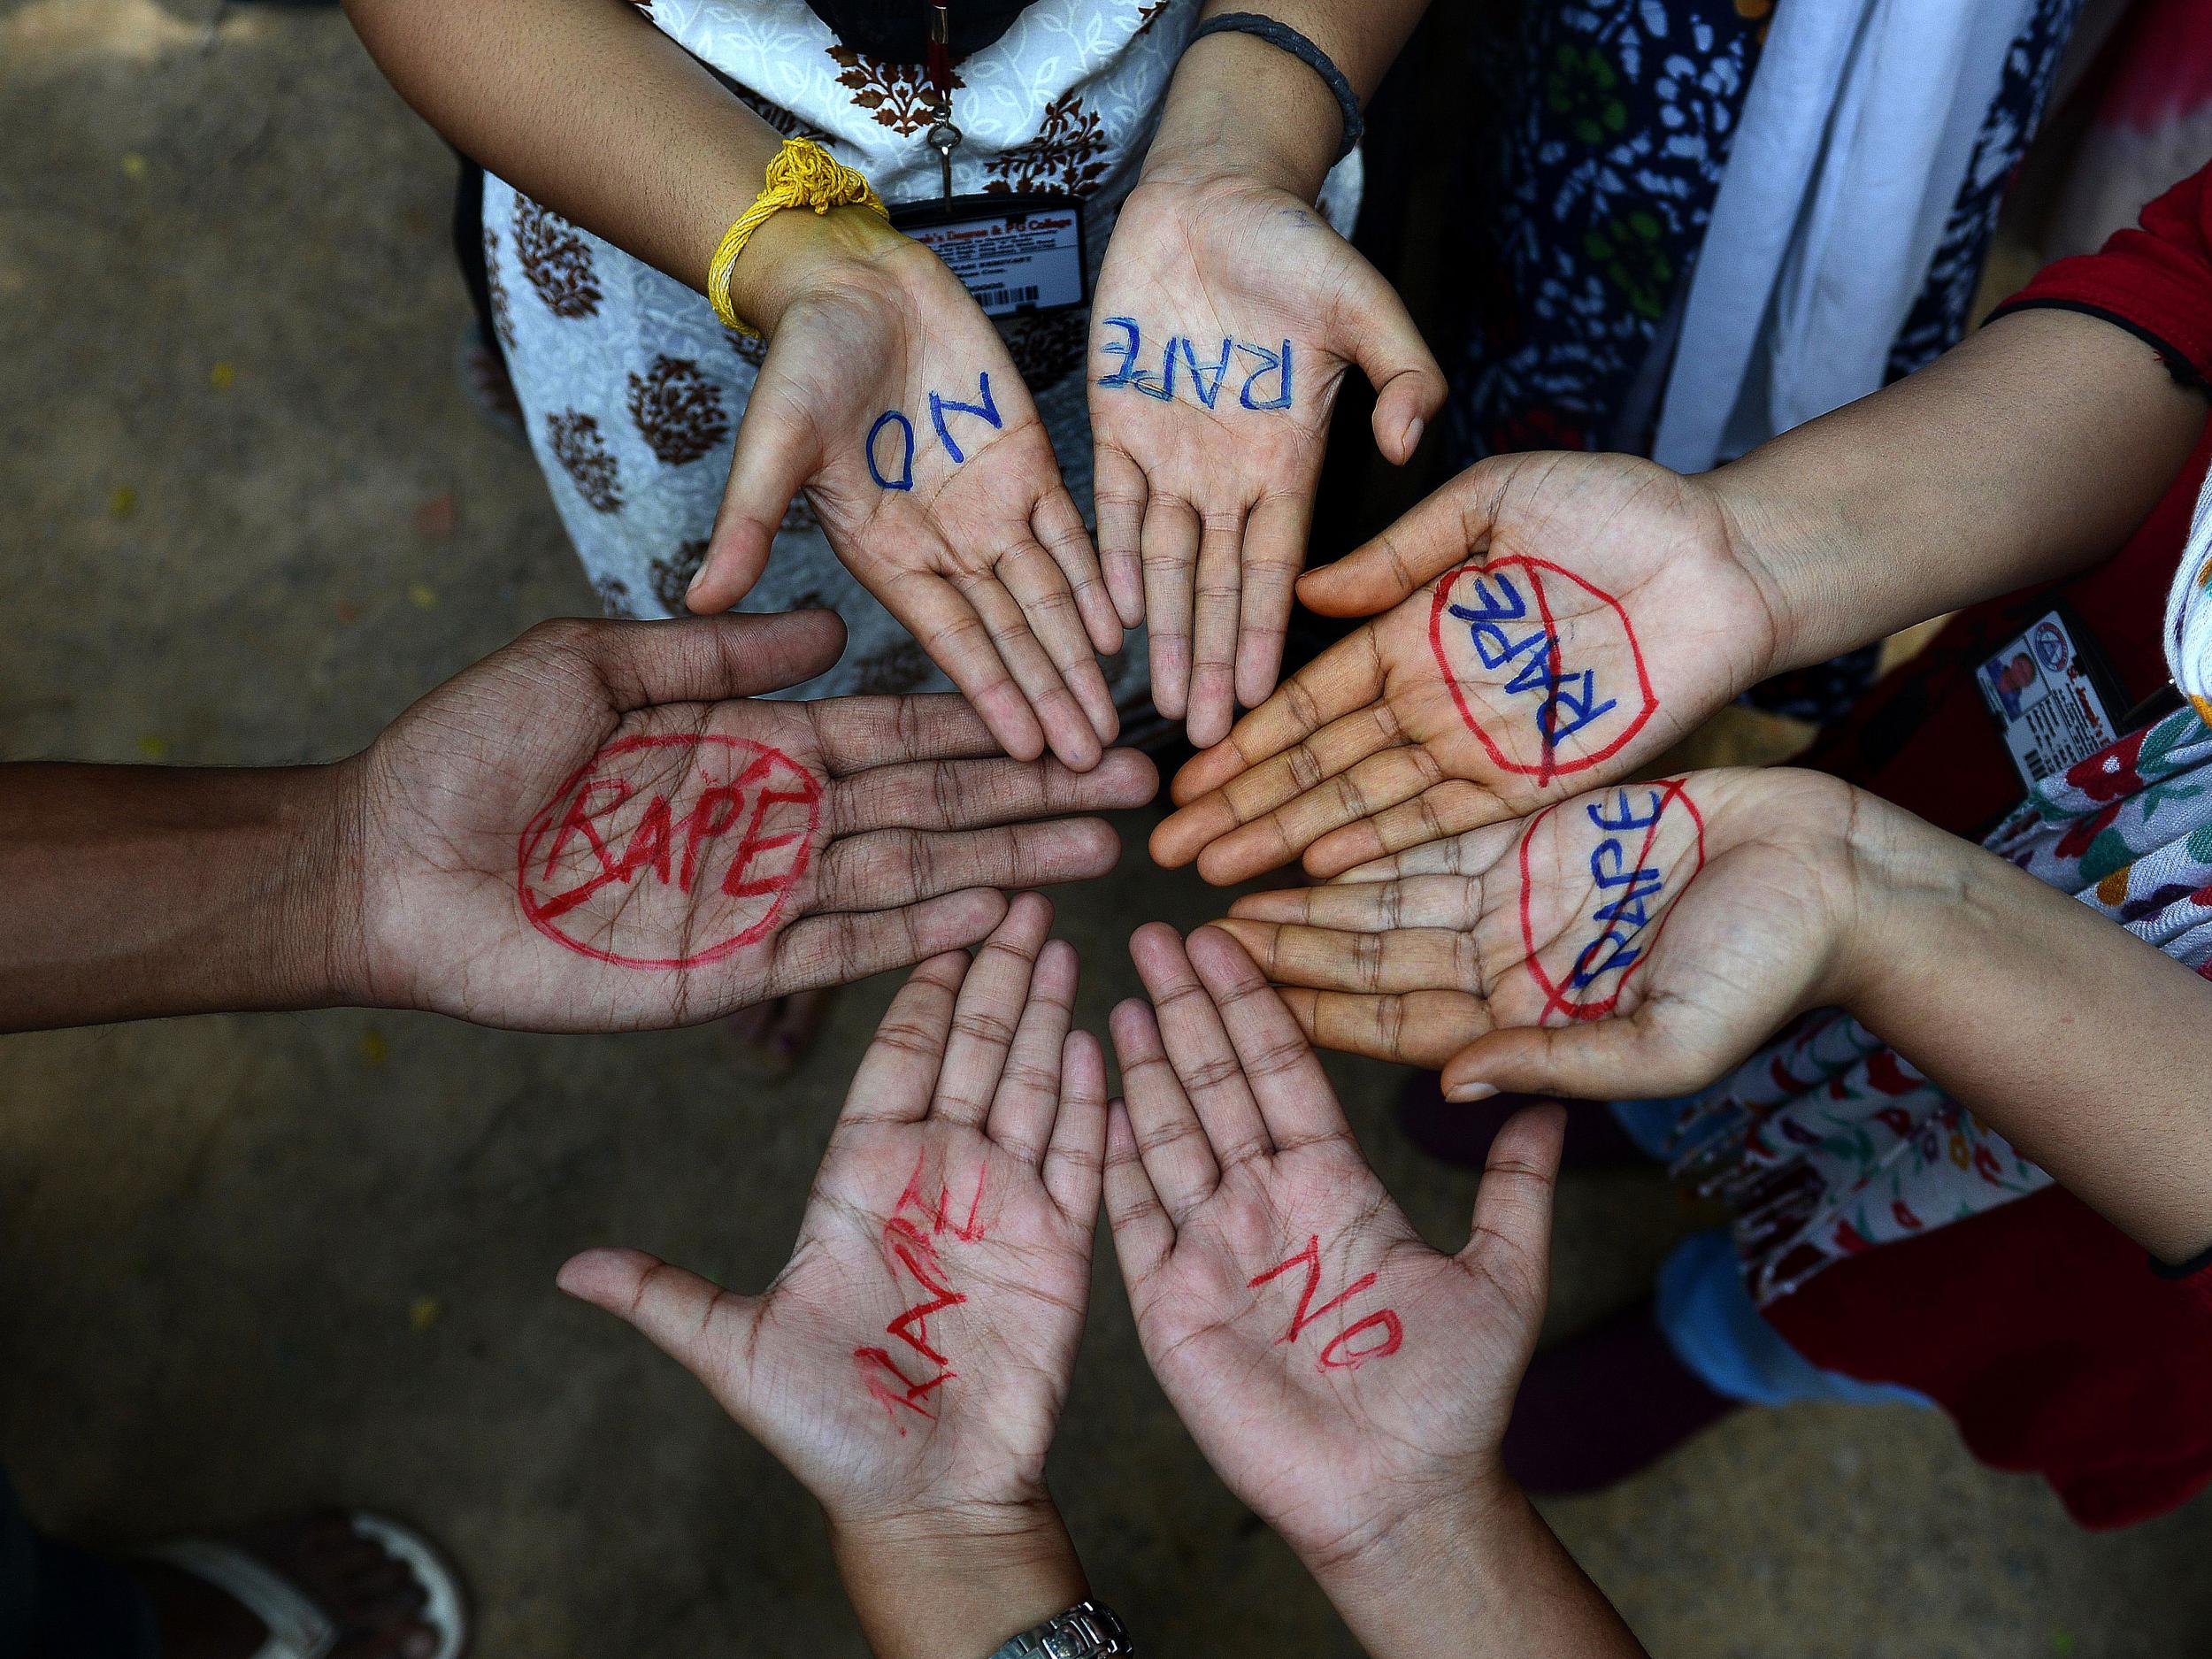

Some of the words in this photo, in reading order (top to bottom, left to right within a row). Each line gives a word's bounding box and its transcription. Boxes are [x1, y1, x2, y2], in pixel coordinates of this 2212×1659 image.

[1097, 317, 1293, 411] RAPE
[865, 372, 1003, 492] NO
[1448, 572, 1617, 748] RAPE
[541, 778, 811, 898] RAPE
[1570, 787, 1663, 990] RAPE
[1246, 1233, 1403, 1370] NO
